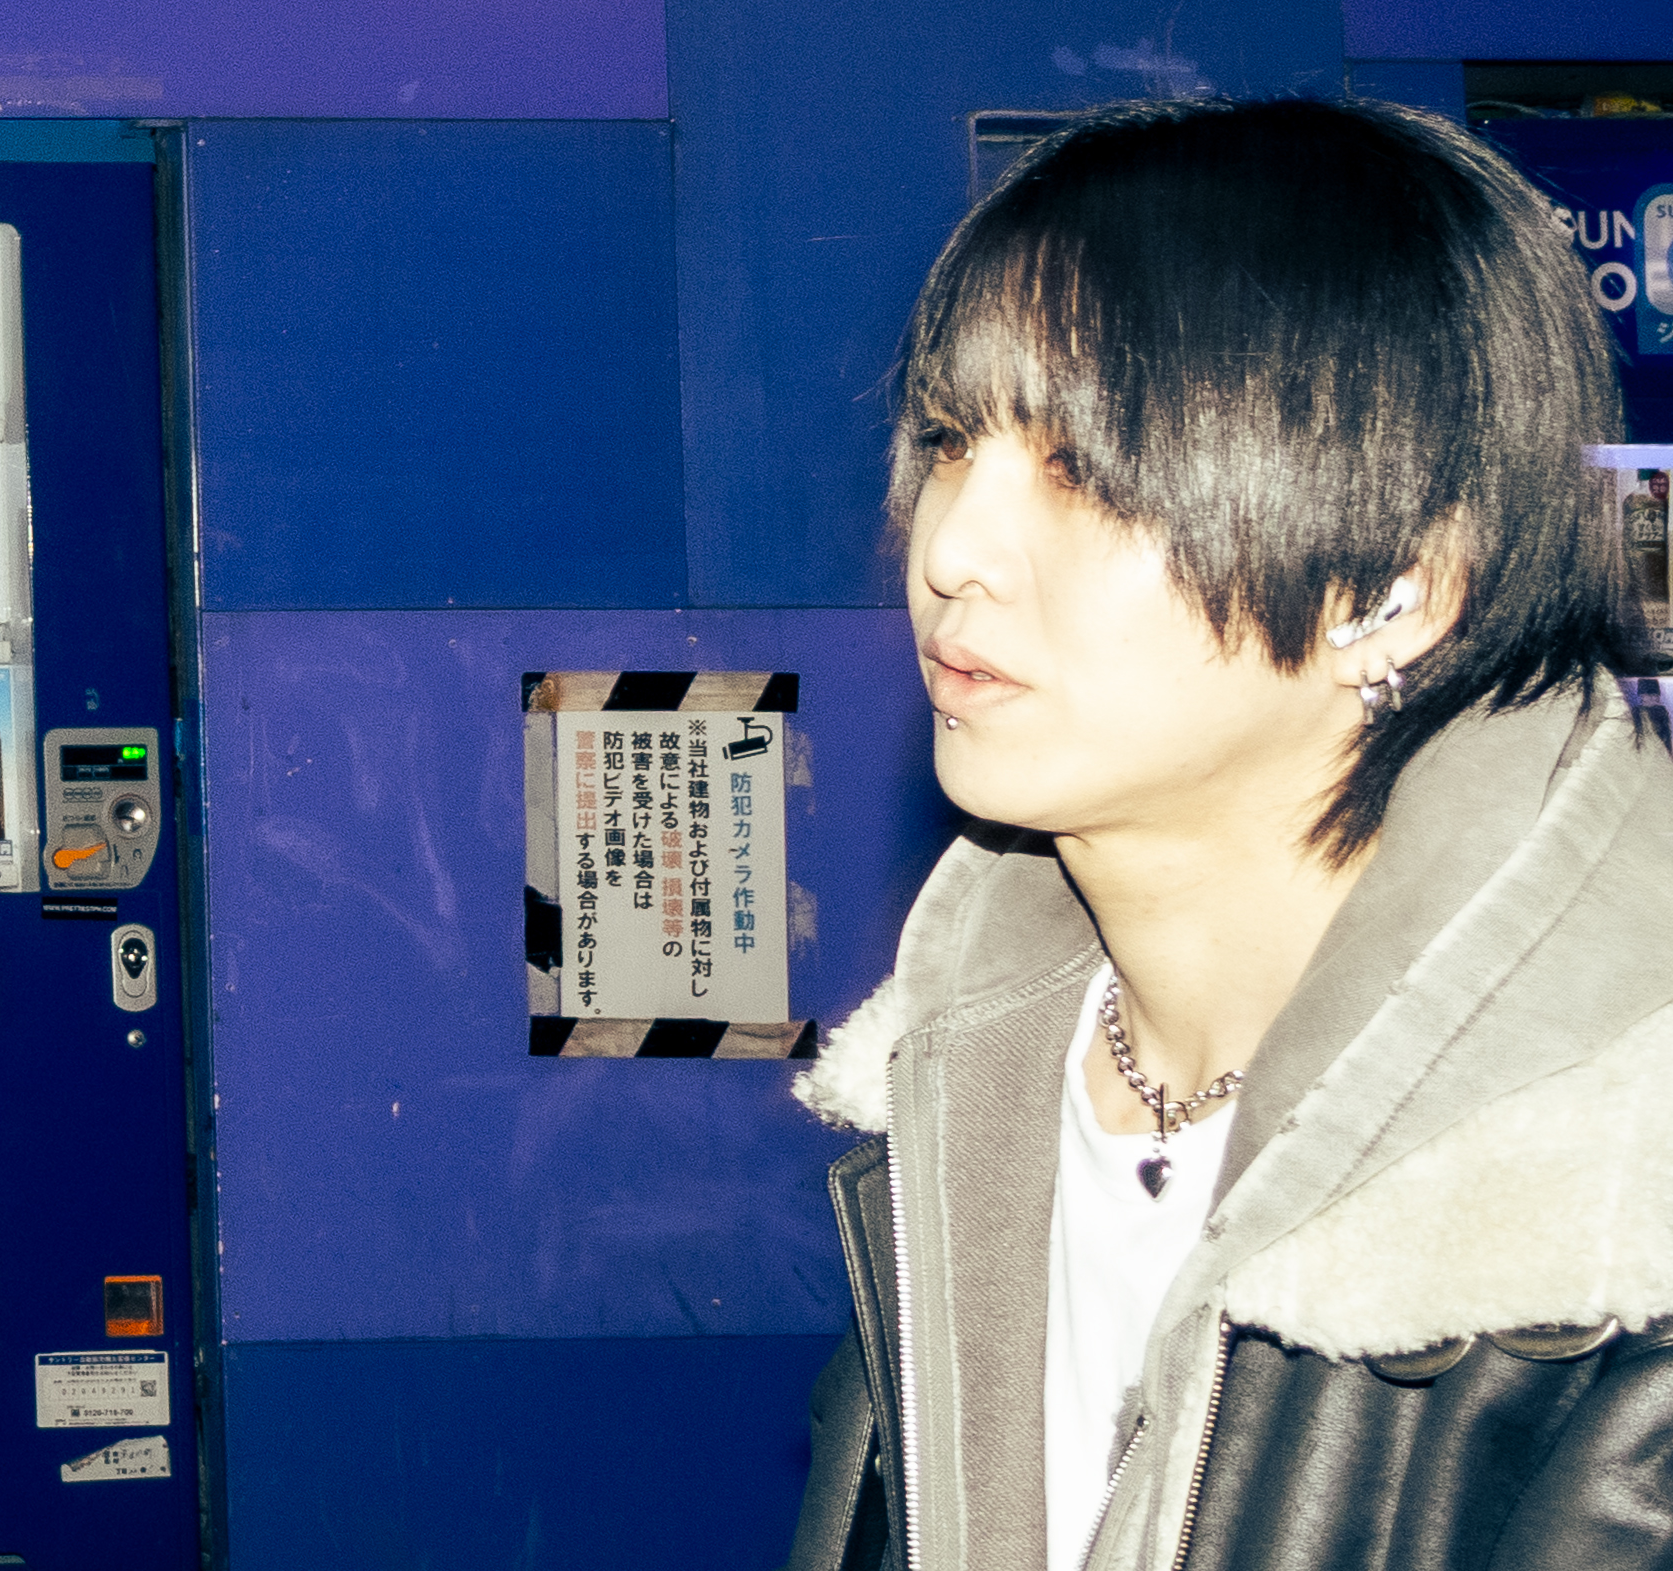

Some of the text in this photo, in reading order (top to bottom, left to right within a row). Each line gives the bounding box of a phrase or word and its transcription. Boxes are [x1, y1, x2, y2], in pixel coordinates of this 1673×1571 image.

[1577, 209, 1637, 251] UN
[603, 731, 627, 888] 防犯ビデオ画像を
[631, 731, 655, 910] 被害を受けた場合は
[730, 771, 755, 955] 防犯カメラ作動中
